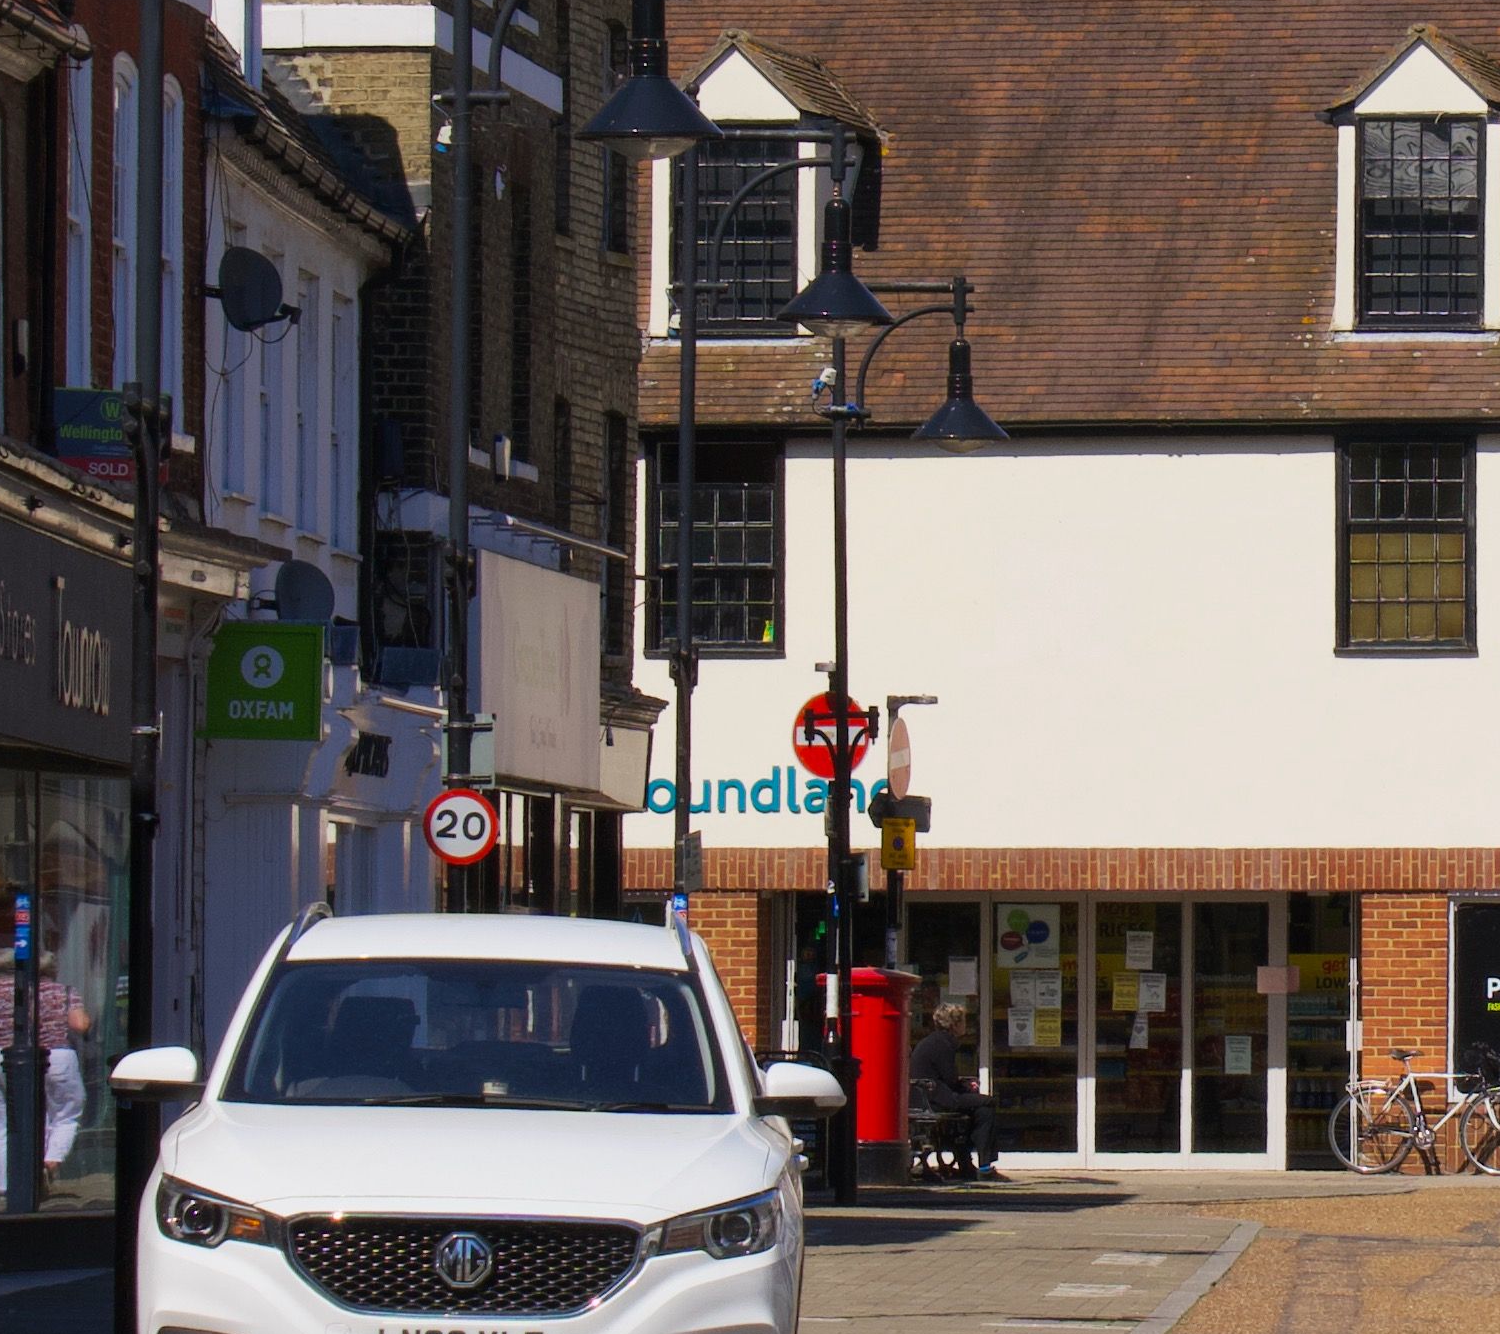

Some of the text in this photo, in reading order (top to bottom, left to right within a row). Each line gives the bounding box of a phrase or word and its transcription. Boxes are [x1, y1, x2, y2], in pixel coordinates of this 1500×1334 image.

[60, 425, 123, 443] Wellingto
[88, 462, 129, 476] SOLD
[228, 700, 295, 721] OXFAM
[646, 765, 892, 815] oundlan
[435, 809, 486, 841] 20
[1315, 977, 1347, 989] LOW
[441, 1238, 487, 1283] MG
